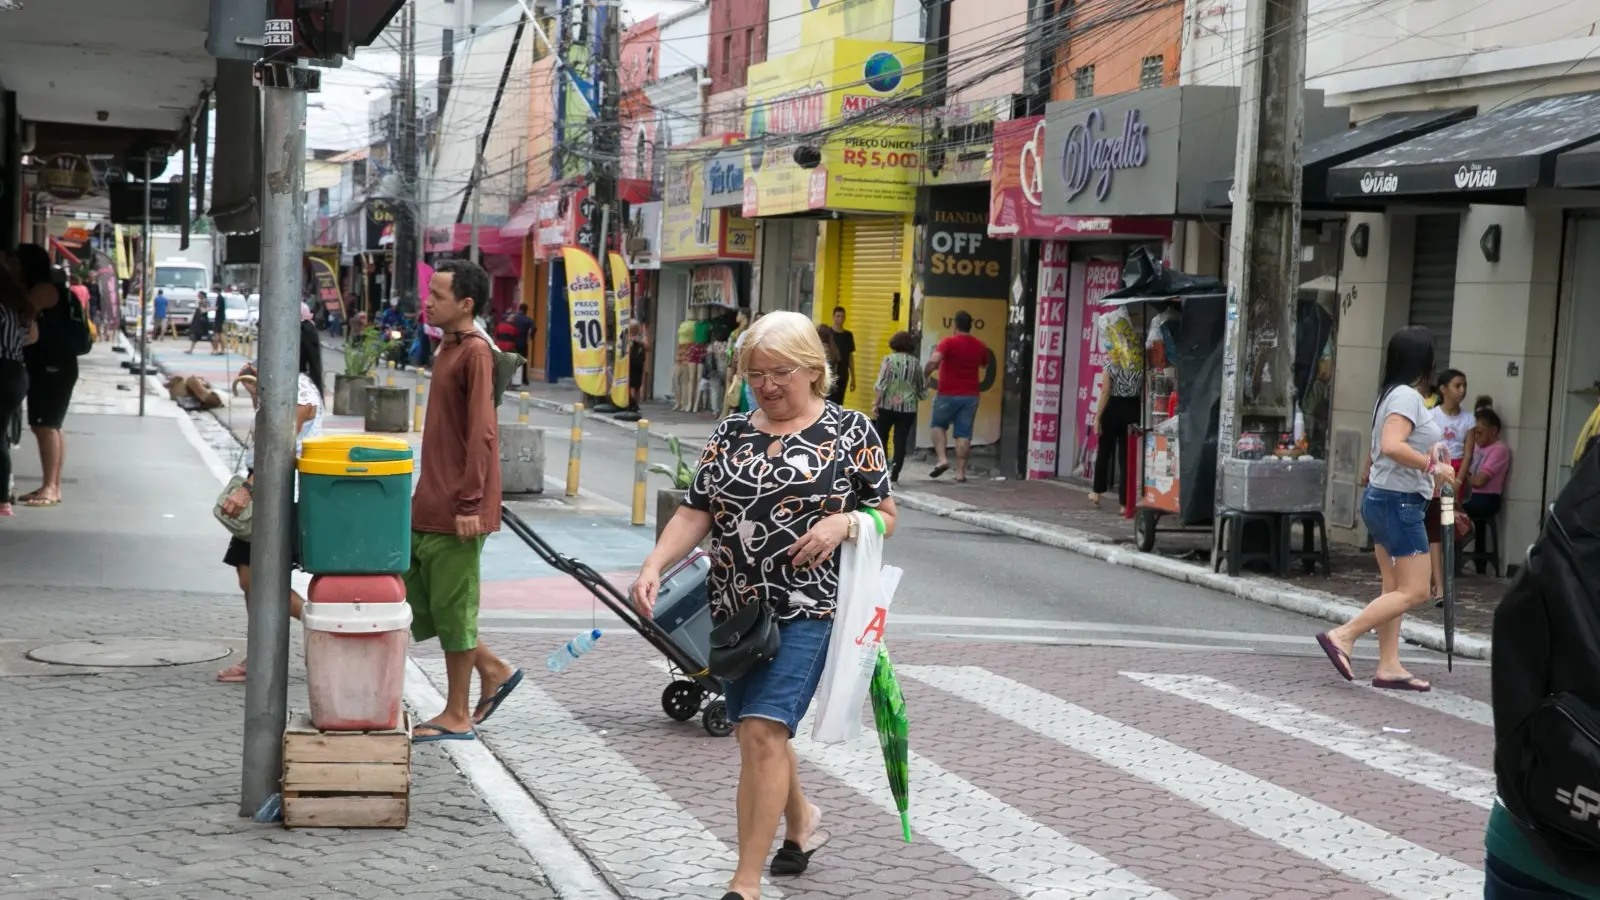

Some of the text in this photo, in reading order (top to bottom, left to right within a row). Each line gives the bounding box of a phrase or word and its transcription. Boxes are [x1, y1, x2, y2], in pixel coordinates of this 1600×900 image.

[845, 138, 878, 149] PREÇO
[843, 149, 867, 167] R$
[734, 234, 746, 245] 20
[931, 231, 982, 254] OFF
[931, 253, 1000, 277] Store
[1086, 266, 1119, 284] PREÇO
[570, 282, 601, 291] Graça
[1009, 305, 1025, 325] 734
[574, 319, 602, 349] 10
